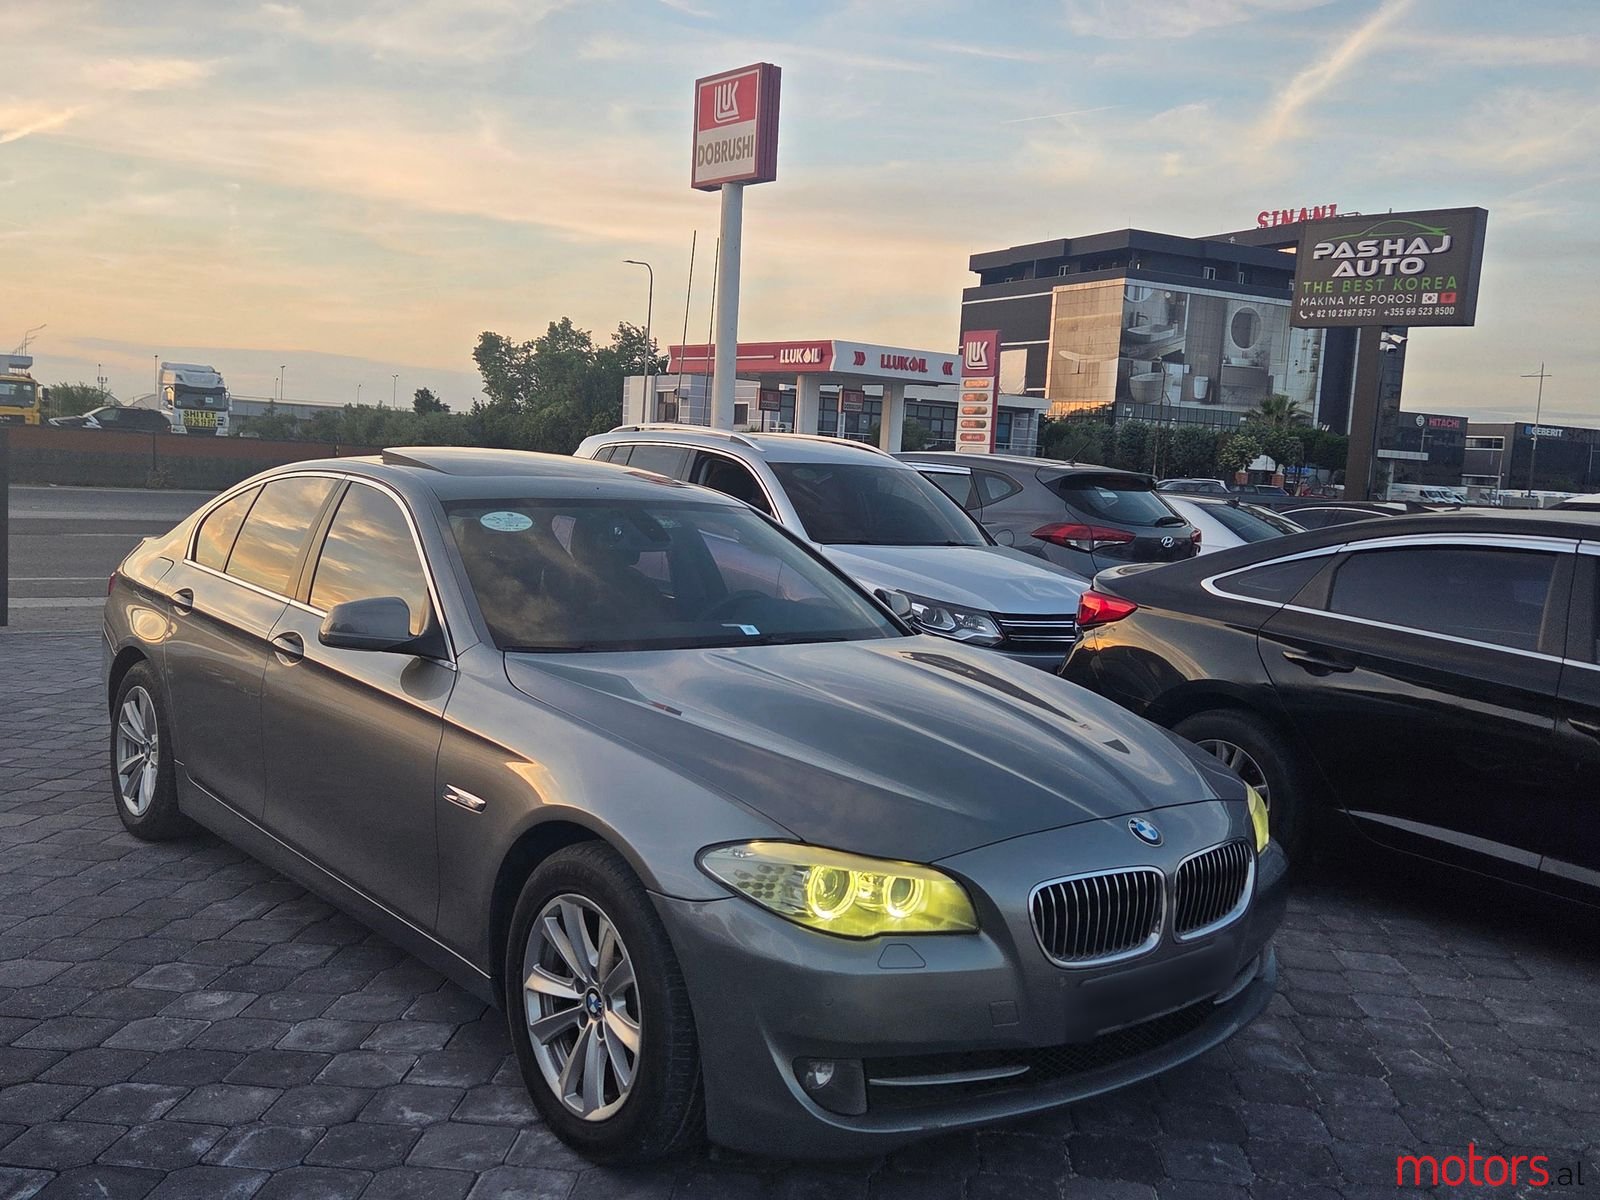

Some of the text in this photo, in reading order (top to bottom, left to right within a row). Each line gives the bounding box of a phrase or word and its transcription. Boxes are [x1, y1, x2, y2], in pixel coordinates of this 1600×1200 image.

[697, 135, 754, 167] DOBRUSHI
[1257, 203, 1337, 227] SINANI
[1313, 235, 1451, 260] PASHAJ
[1332, 257, 1425, 278] AUTO
[1303, 275, 1457, 294] THE BEST KOREA
[1300, 293, 1417, 307] MAKINA ME POROSI
[1316, 309, 1326, 318] 82
[1328, 309, 1337, 318] 10
[1338, 308, 1357, 317] 2187
[1358, 308, 1376, 317] 8751
[1383, 306, 1455, 317] +355 69 523 8500
[183, 410, 216, 418] SHITET
[1429, 417, 1460, 428] HITACHI
[1531, 427, 1563, 437] GEBERIT
